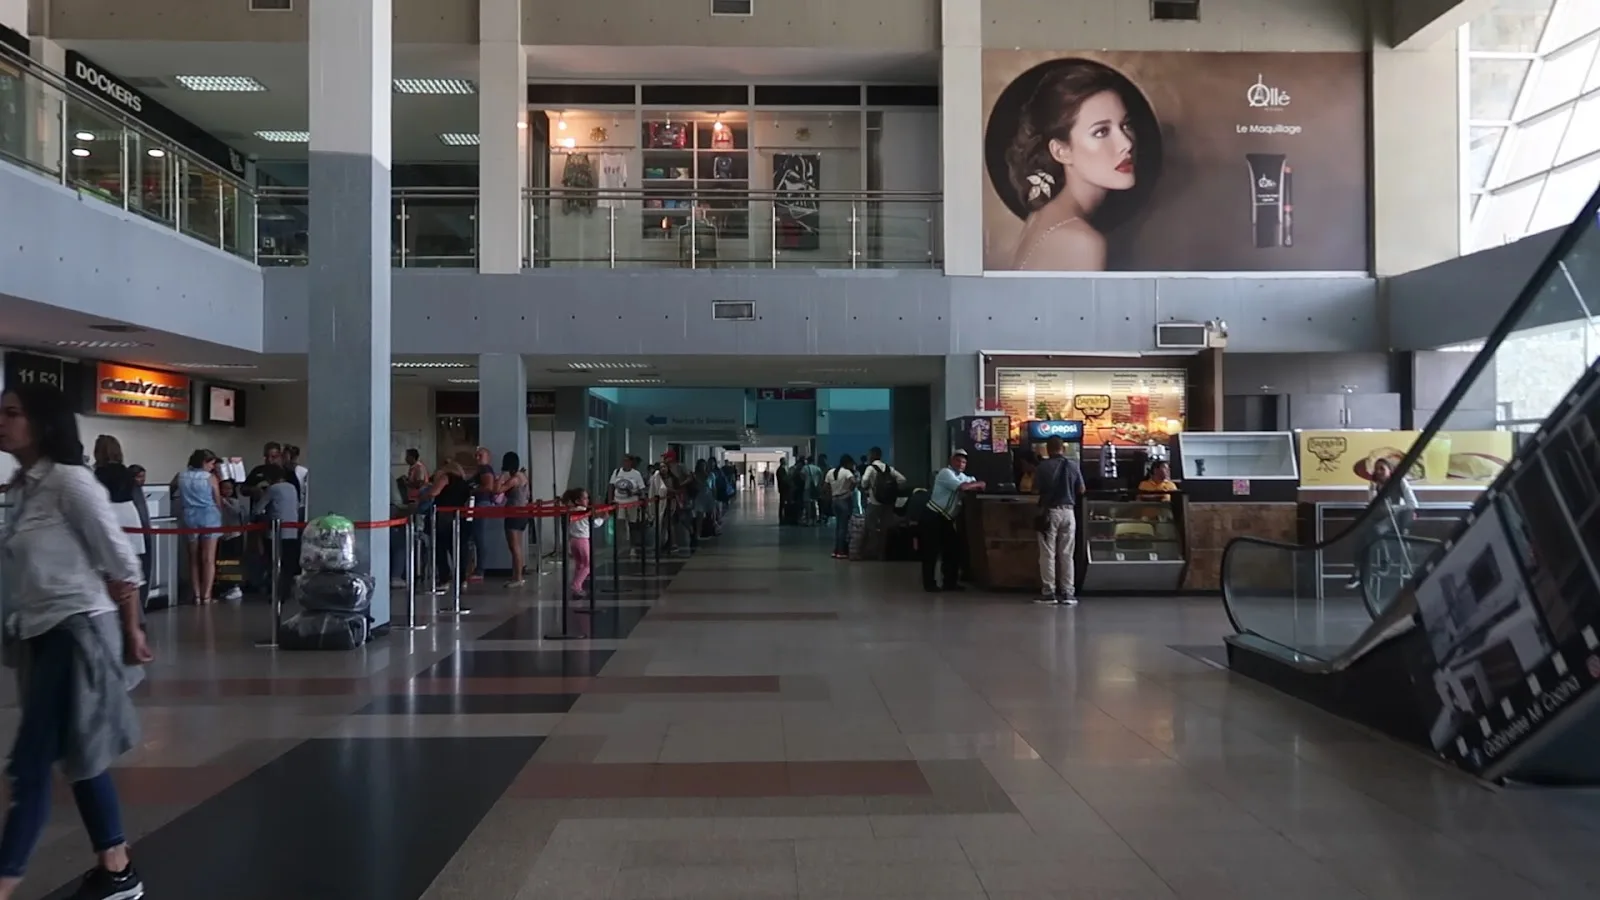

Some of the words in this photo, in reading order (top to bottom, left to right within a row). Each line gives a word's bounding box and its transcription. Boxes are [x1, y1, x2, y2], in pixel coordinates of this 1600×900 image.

[76, 60, 142, 112] DOCKERS
[1236, 124, 1247, 134] Le
[1249, 124, 1302, 135] Maquillage
[1051, 424, 1078, 434] pepsi
